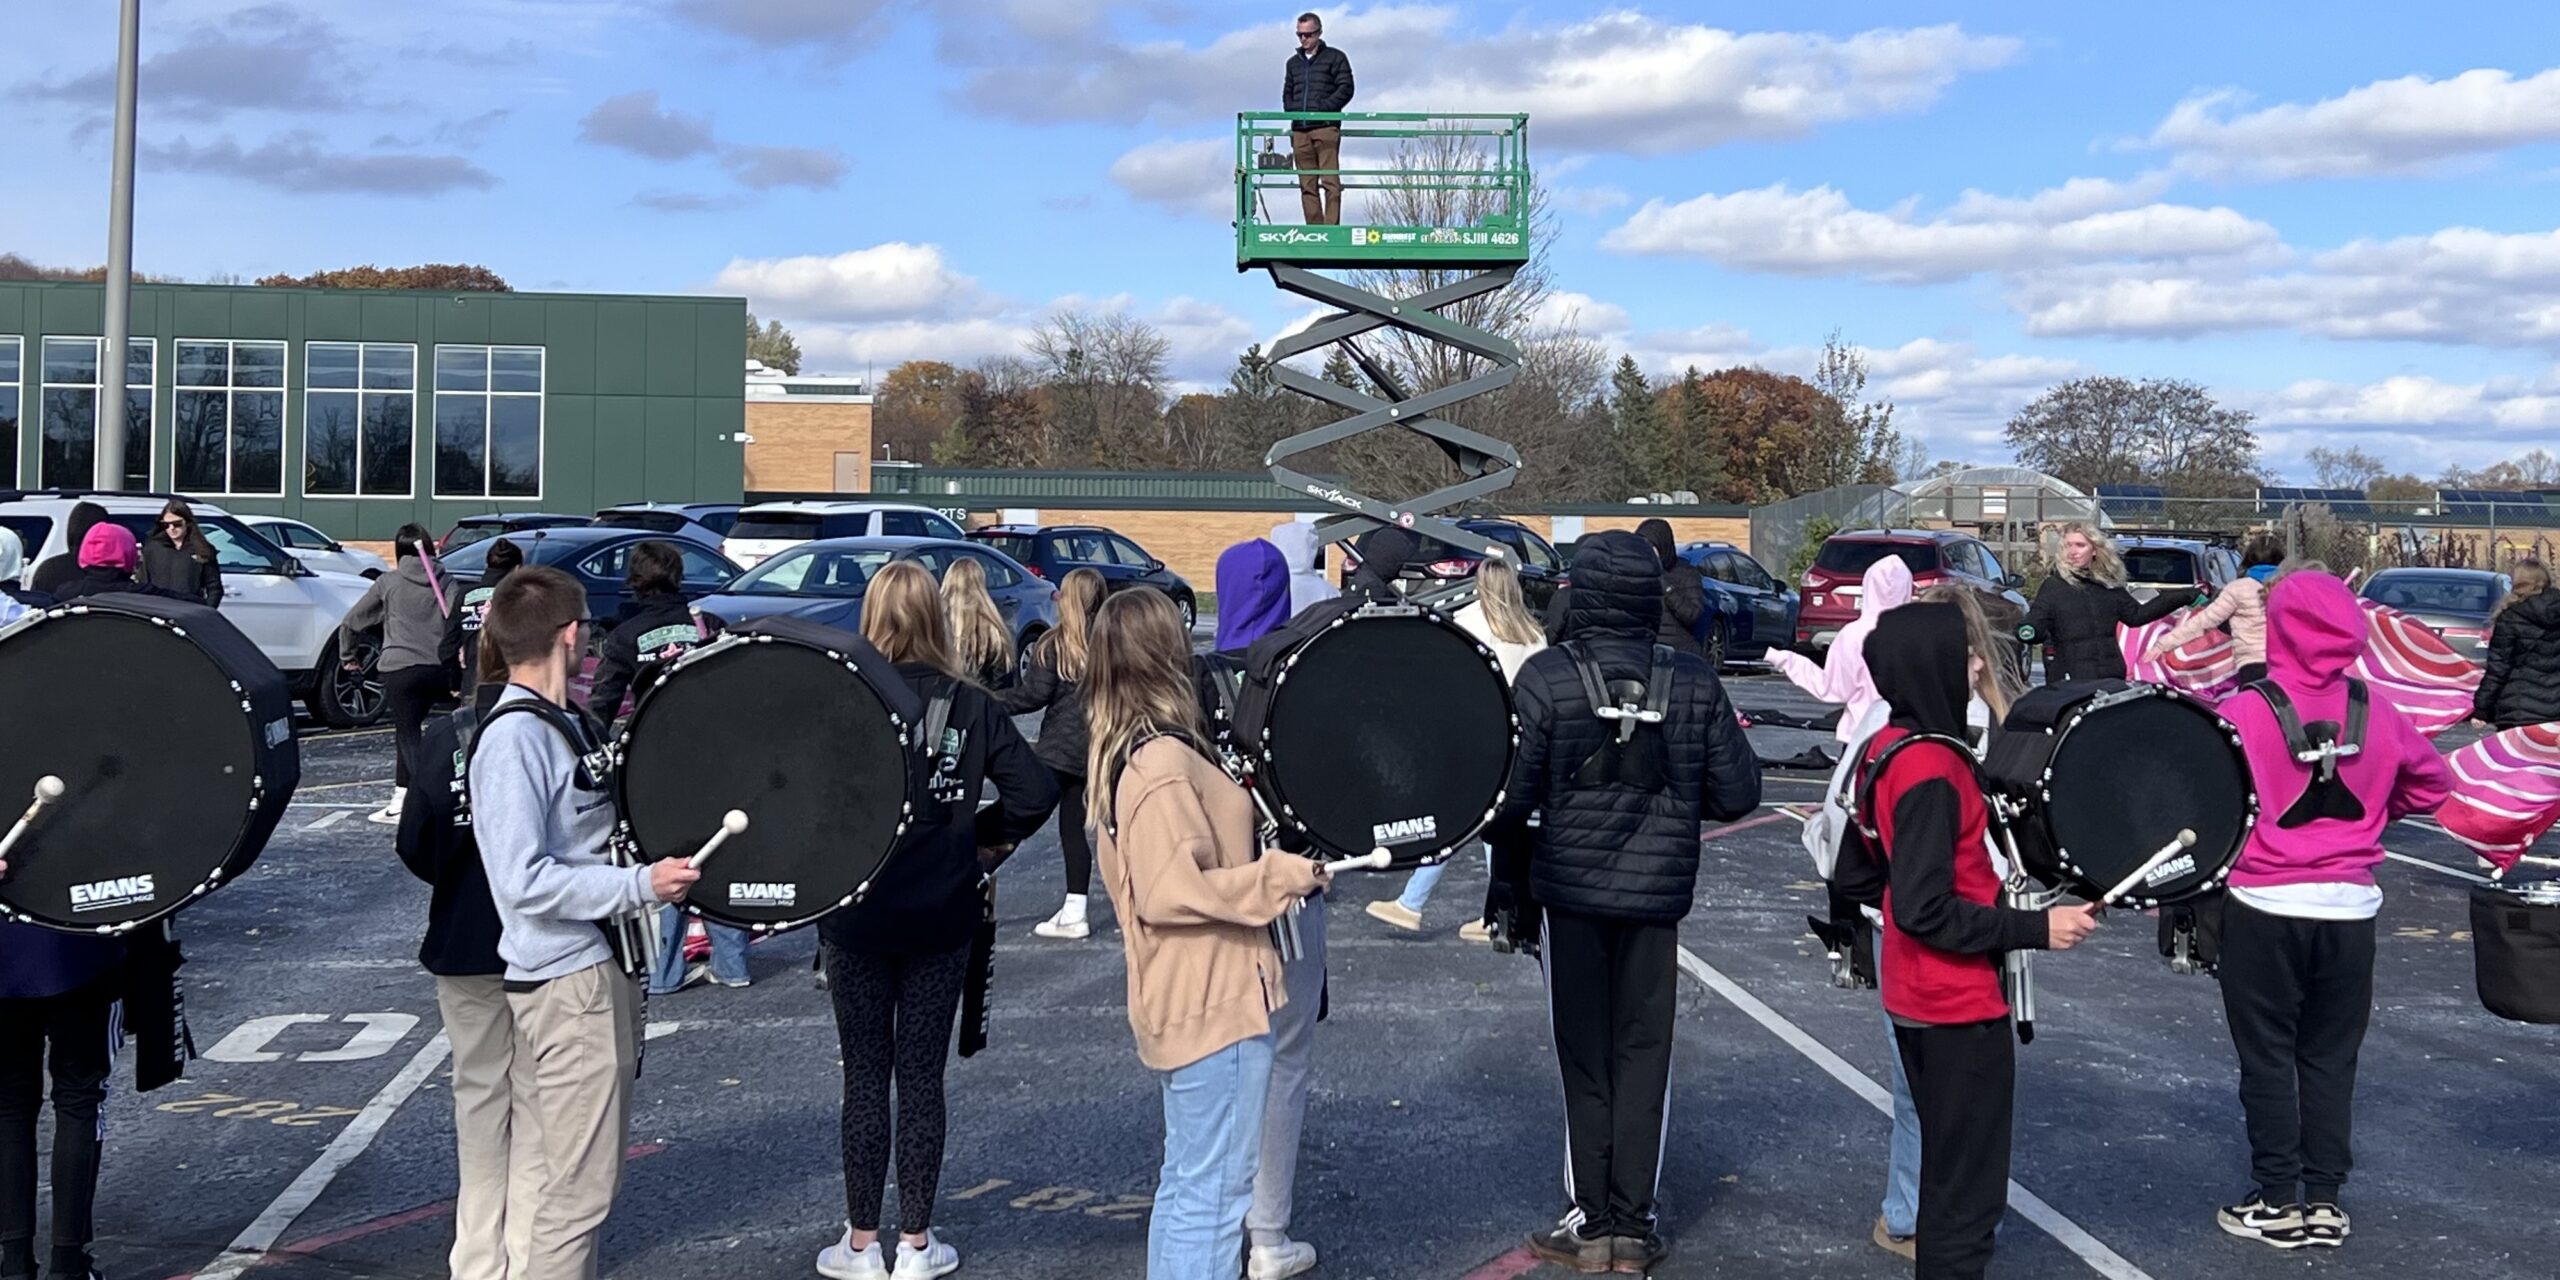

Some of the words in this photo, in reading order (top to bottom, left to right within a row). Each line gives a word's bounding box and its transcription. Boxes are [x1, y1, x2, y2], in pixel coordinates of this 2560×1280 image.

[1258, 228, 1329, 244] SKYJACK
[1490, 232, 1519, 245] 4626
[1306, 484, 1362, 509] SKYJACK
[1373, 815, 1436, 841] EVANS
[2145, 854, 2195, 882] EVANS
[69, 874, 154, 904] EVANS
[729, 882, 796, 899] EVANS
